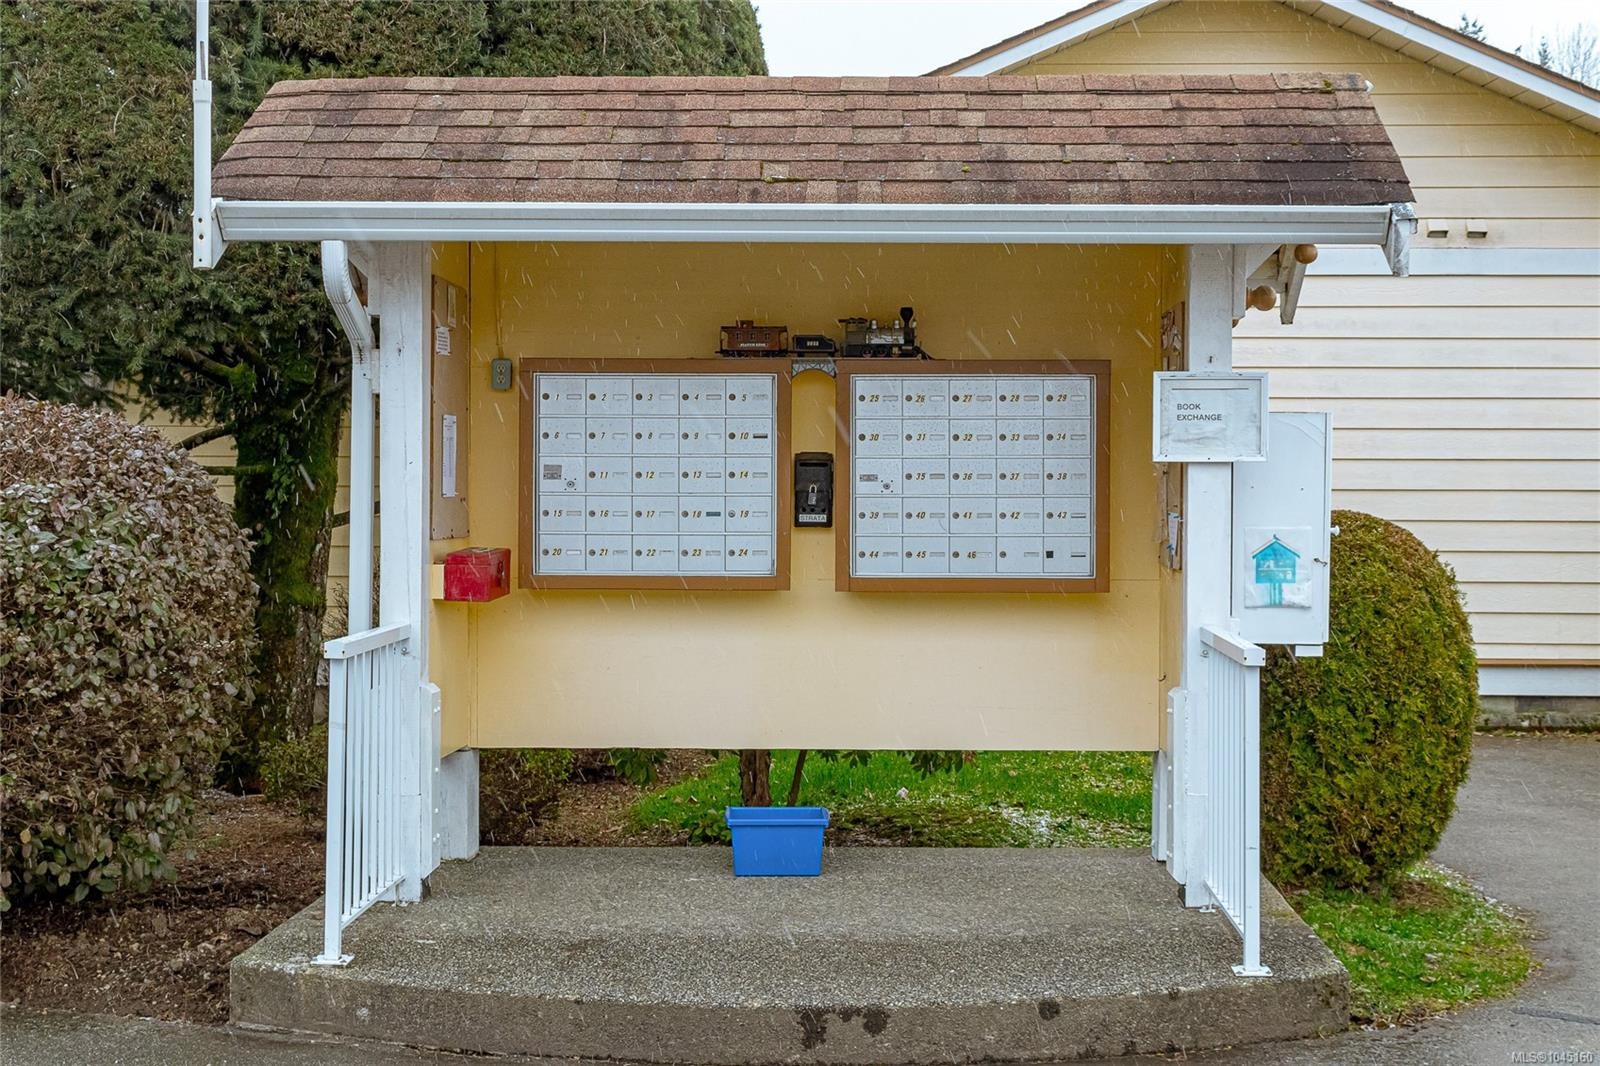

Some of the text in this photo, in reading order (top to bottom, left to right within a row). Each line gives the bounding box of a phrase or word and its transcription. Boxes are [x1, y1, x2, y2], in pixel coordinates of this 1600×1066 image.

[869, 394, 880, 402] 25
[962, 394, 973, 402] 27
[1056, 394, 1067, 402] 29
[1176, 403, 1201, 411] BOOK
[1176, 413, 1223, 422] EXCHANGE
[740, 432, 749, 440] 10
[869, 433, 880, 441] 30
[916, 433, 926, 441] 31
[962, 433, 973, 442] 32
[600, 471, 609, 479] 11
[645, 471, 655, 479] 12
[693, 471, 702, 479] 13
[740, 471, 749, 479] 14
[915, 472, 926, 481] 35
[1009, 472, 1020, 481] 37
[553, 510, 563, 518] 15
[600, 510, 609, 518] 16
[646, 510, 656, 518] 17
[869, 511, 880, 520] 39
[915, 511, 926, 520] 40
[963, 511, 973, 520] 41
[1010, 511, 1021, 520] 42
[552, 548, 562, 556] 20
[599, 548, 609, 557] 21
[646, 549, 657, 557] 22
[691, 548, 702, 557] 23
[738, 548, 748, 557] 24
[869, 550, 879, 559] 44
[916, 550, 927, 559] 45
[966, 550, 977, 559] 46
